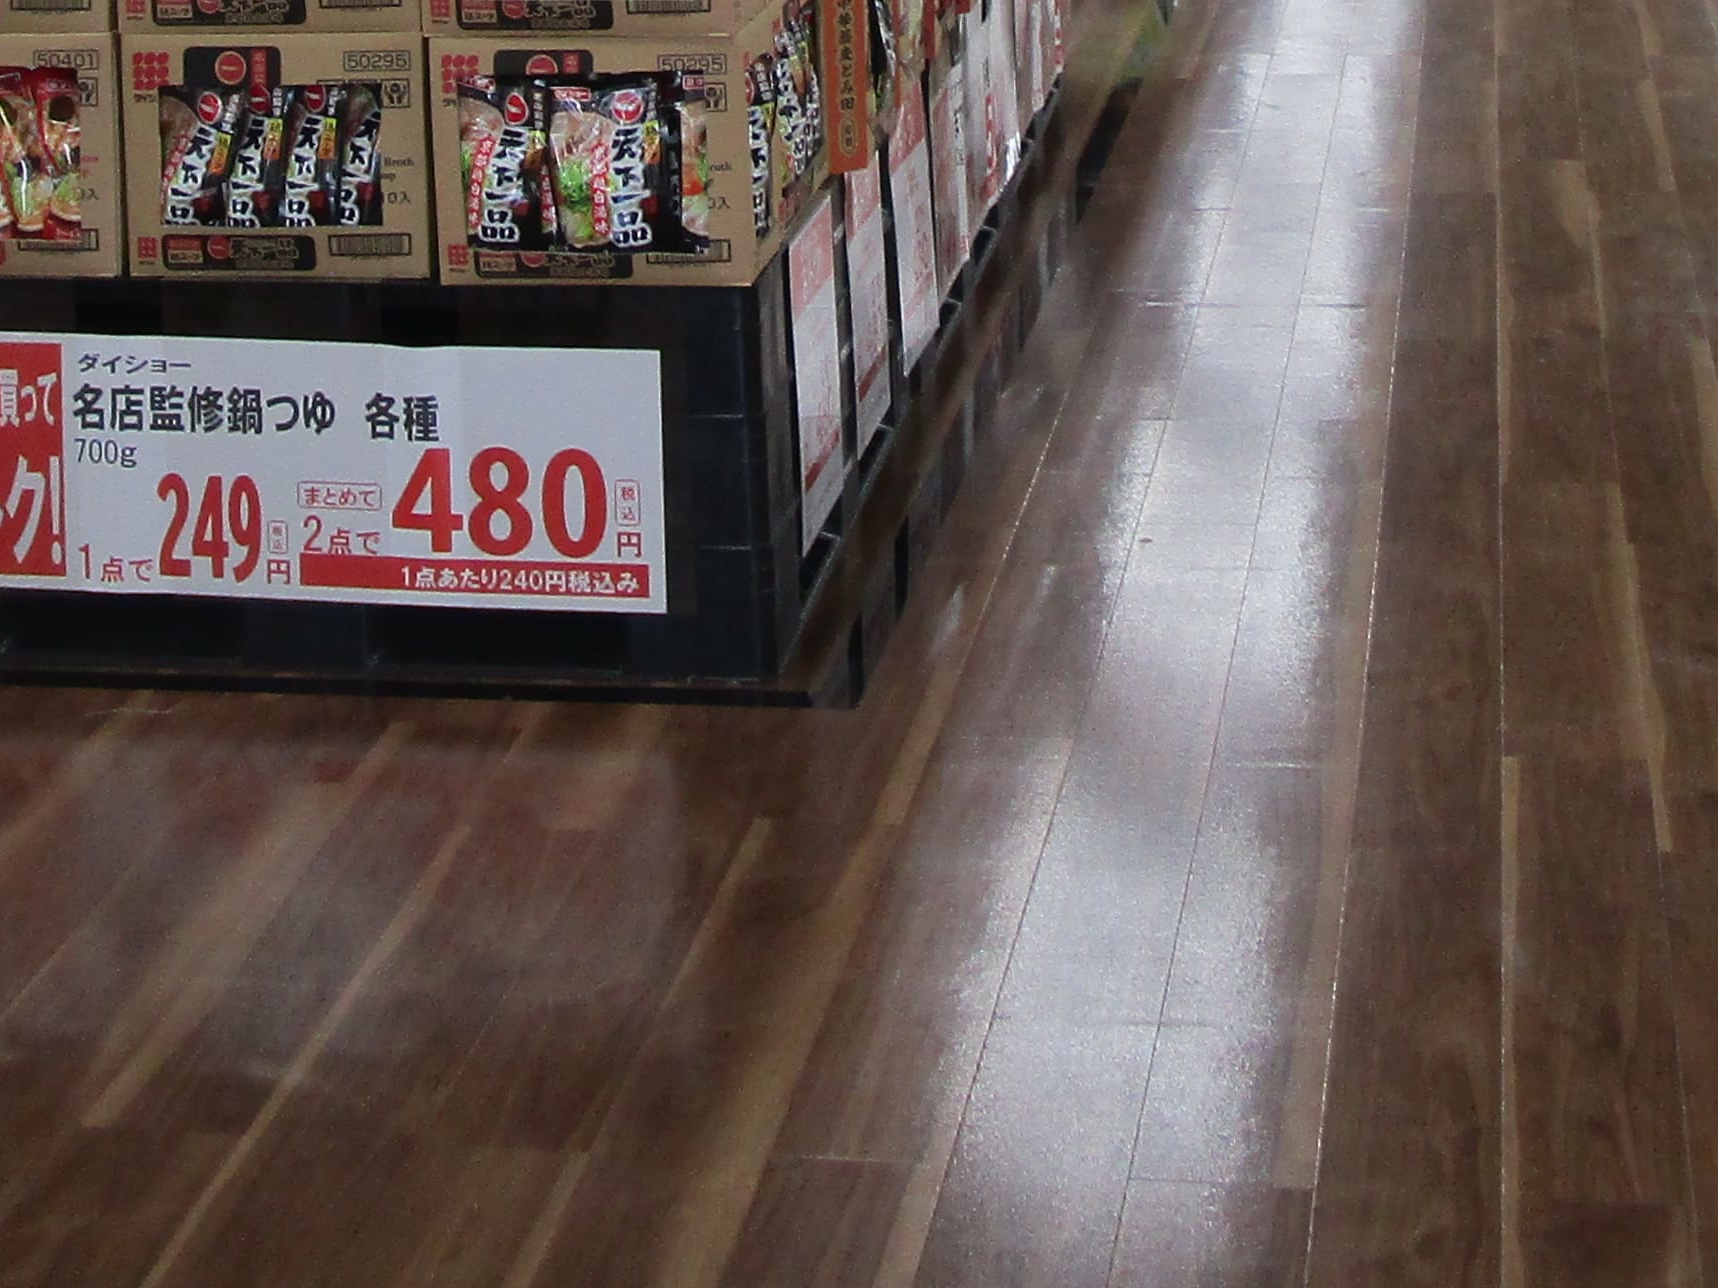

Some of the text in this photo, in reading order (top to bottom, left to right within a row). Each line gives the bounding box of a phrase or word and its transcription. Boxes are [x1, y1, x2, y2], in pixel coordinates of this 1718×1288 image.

[36, 51, 96, 67] 50401
[347, 53, 407, 69] 50295
[659, 57, 724, 72] 50295
[480, 125, 529, 243] 天下一品
[611, 125, 653, 247] 天下一品
[78, 353, 192, 374] ダイショー
[72, 383, 440, 442] 名店監修鍋つゆ 各種
[74, 437, 138, 468] 700g
[302, 484, 378, 509] まとめて
[302, 514, 381, 556] 2点で
[391, 445, 609, 559] 480
[615, 529, 642, 558] 円
[78, 544, 154, 585] 1点で
[158, 472, 263, 584] 249
[266, 559, 291, 586] 円
[400, 565, 641, 596] 1点あたり240円税込み
